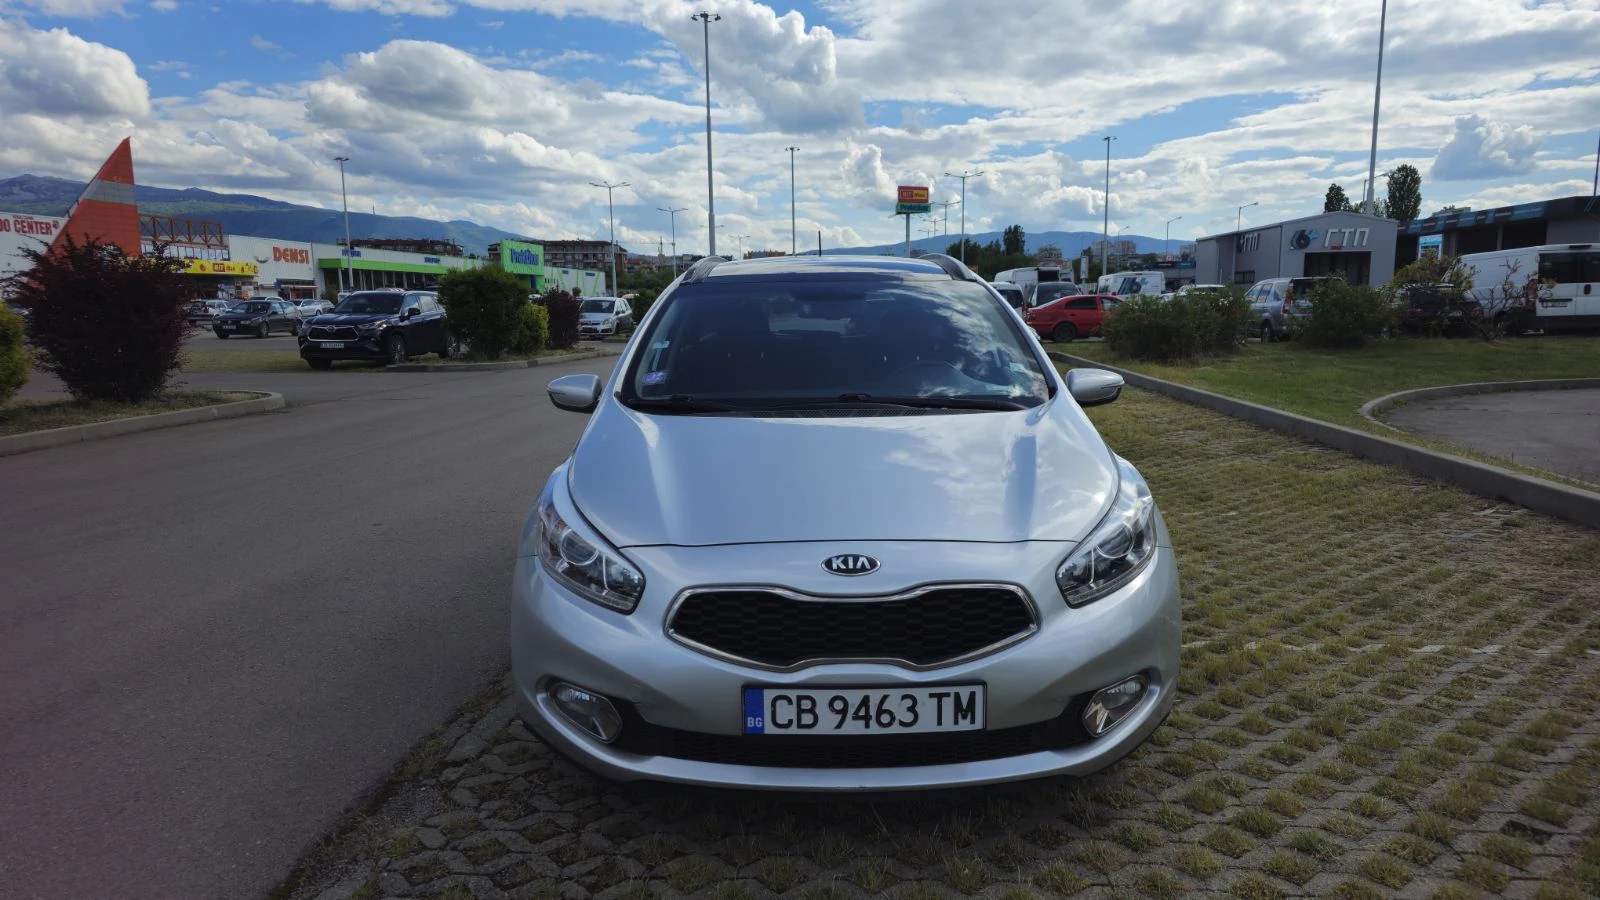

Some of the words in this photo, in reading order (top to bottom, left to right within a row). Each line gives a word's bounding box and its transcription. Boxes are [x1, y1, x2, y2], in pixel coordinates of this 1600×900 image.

[14, 219, 52, 235] CENTER
[272, 246, 310, 265] DENSI
[831, 556, 871, 570] KIA
[770, 694, 819, 729] CB
[828, 693, 919, 729] 9463
[928, 691, 976, 727] TM
[747, 717, 763, 728] BG
